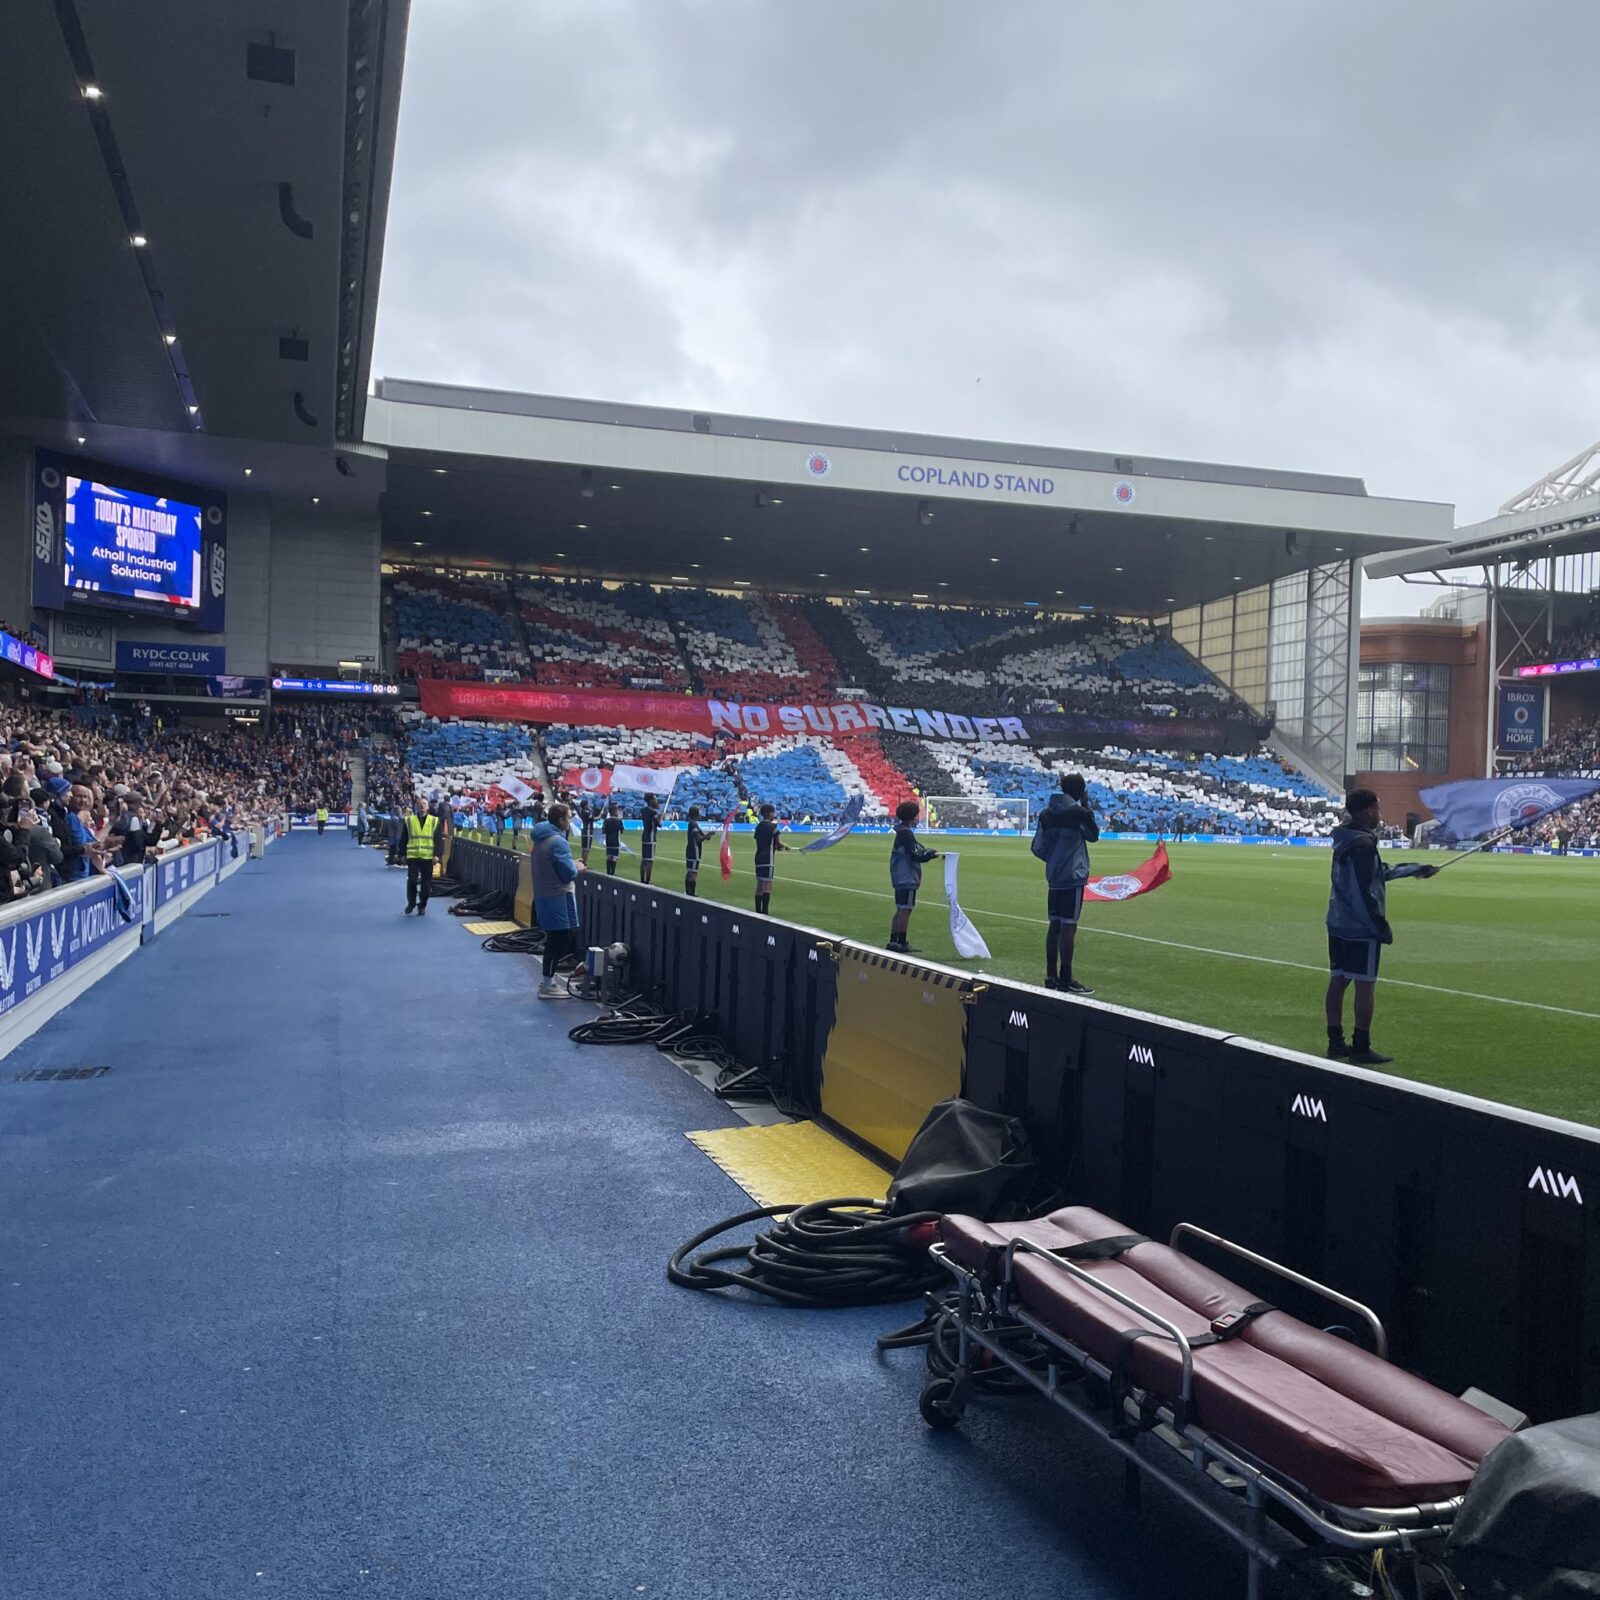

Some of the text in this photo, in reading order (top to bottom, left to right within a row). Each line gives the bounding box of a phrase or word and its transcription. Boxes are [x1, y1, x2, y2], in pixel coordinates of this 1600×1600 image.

[898, 465, 1055, 495] COPLAND STAND
[95, 498, 178, 536] TODAY'S MATCHDAY
[35, 502, 54, 563] SEKO
[116, 525, 156, 553] SPONSOR
[92, 546, 177, 571] Atholl Industrial
[111, 563, 162, 583] Solutions
[210, 542, 225, 598] SEKO
[62, 623, 104, 639] IBROX
[62, 638, 105, 652] SUITE
[133, 648, 210, 662] RYDC.CO.UK
[1507, 693, 1536, 702] IBROX
[225, 708, 246, 716] EXIT
[707, 700, 1031, 741] NO SURRENDER
[1506, 734, 1535, 743] HOME
